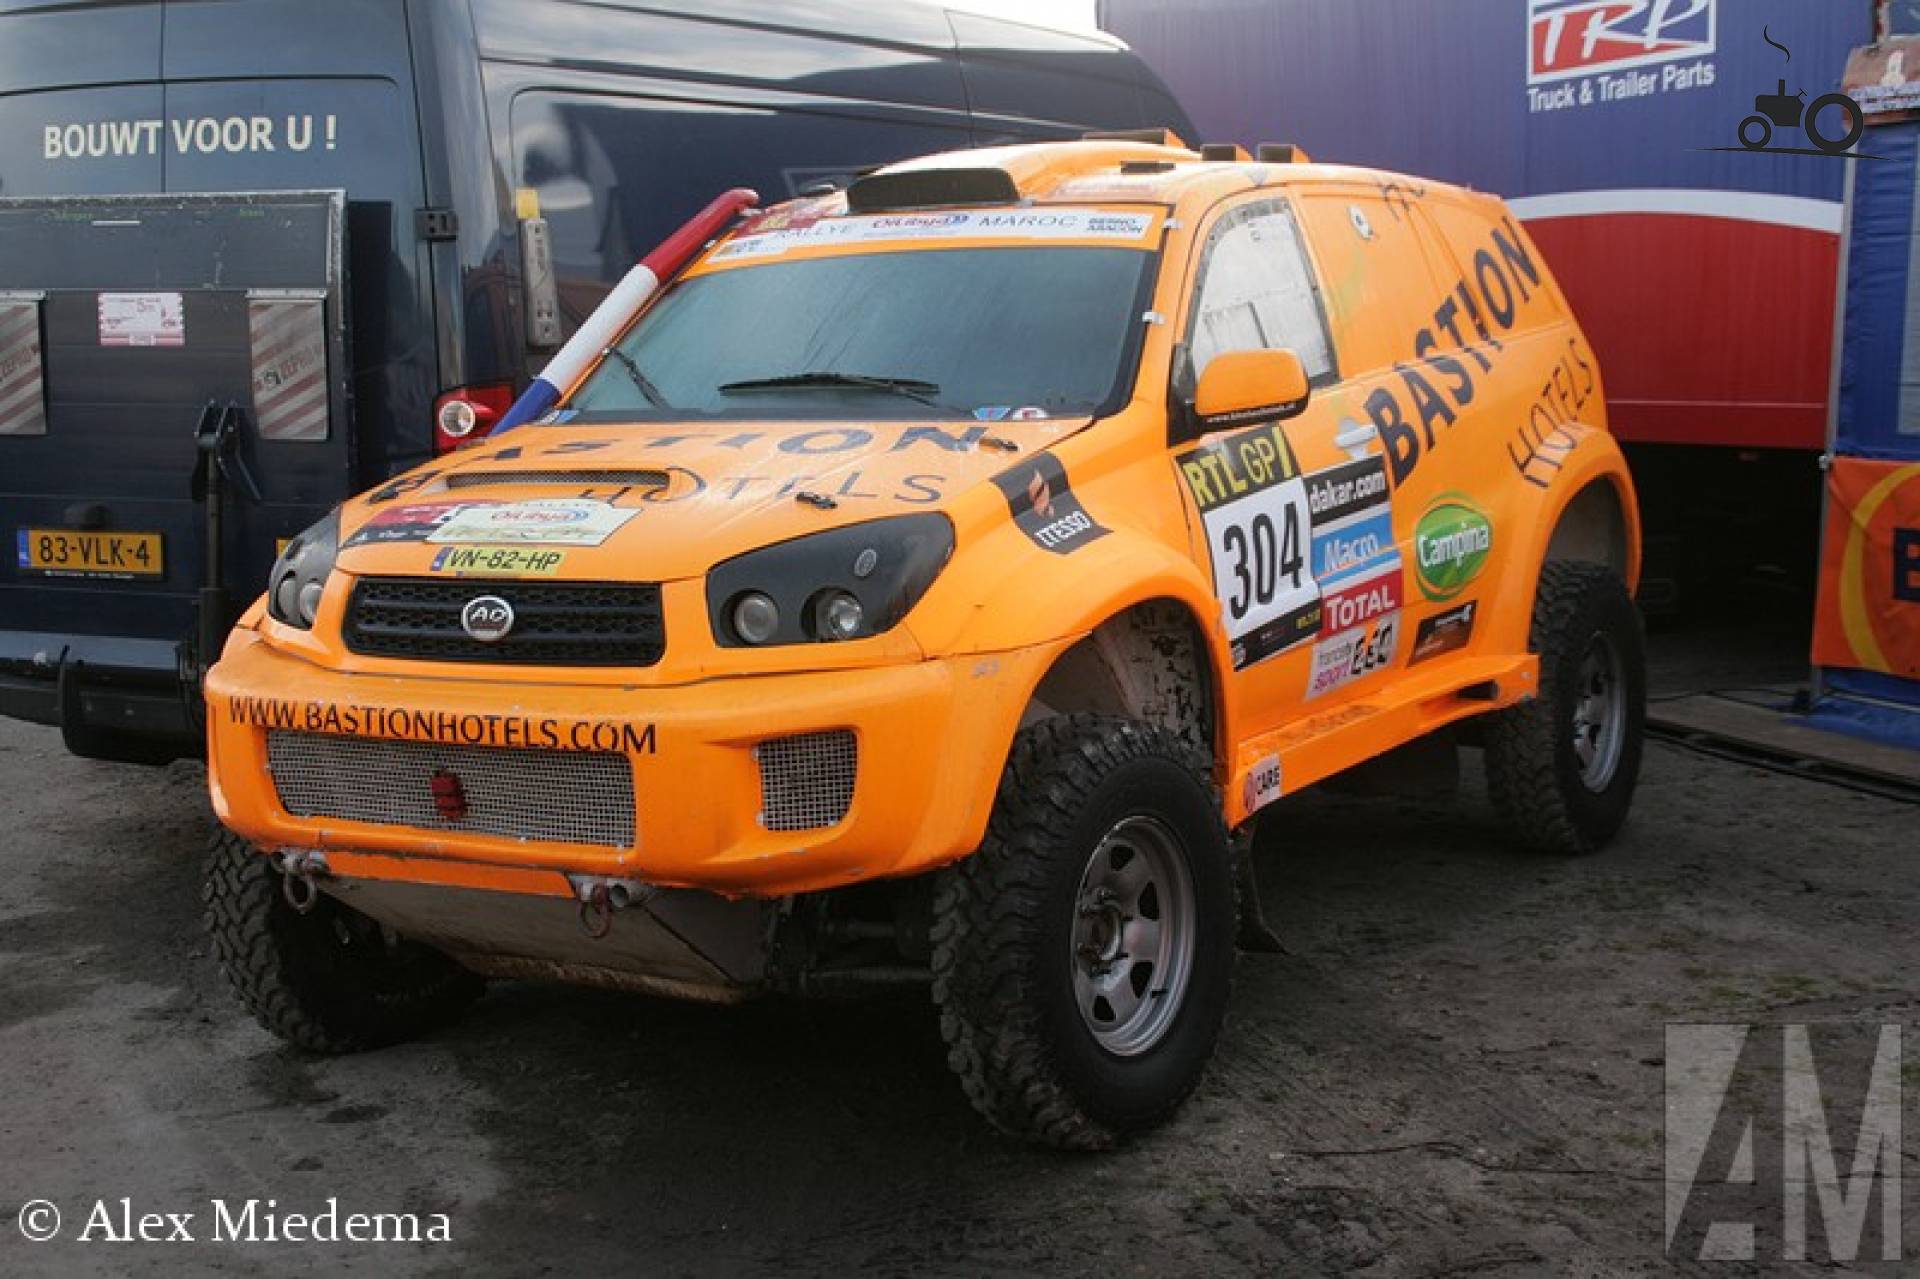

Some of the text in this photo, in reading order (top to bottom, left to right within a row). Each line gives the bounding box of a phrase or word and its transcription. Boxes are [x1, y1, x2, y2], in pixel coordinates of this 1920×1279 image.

[1528, 61, 1715, 113] Truck & Trailer Parts
[44, 115, 337, 160] BOUWT VOOR U !
[977, 215, 1079, 228] MAROC
[1362, 218, 1542, 490] BASTION
[1506, 338, 1594, 490] HOTELS
[1181, 451, 1250, 508] RTL
[1309, 469, 1387, 515] dakar.com
[38, 534, 150, 568] 83-VLK-4
[449, 549, 561, 572] VN-82-HP
[1222, 501, 1305, 621] 304
[1418, 516, 1490, 568] Campina
[1326, 584, 1396, 631] TOTAL
[229, 695, 658, 756] WWW.BASTIONHOTELS.COM
